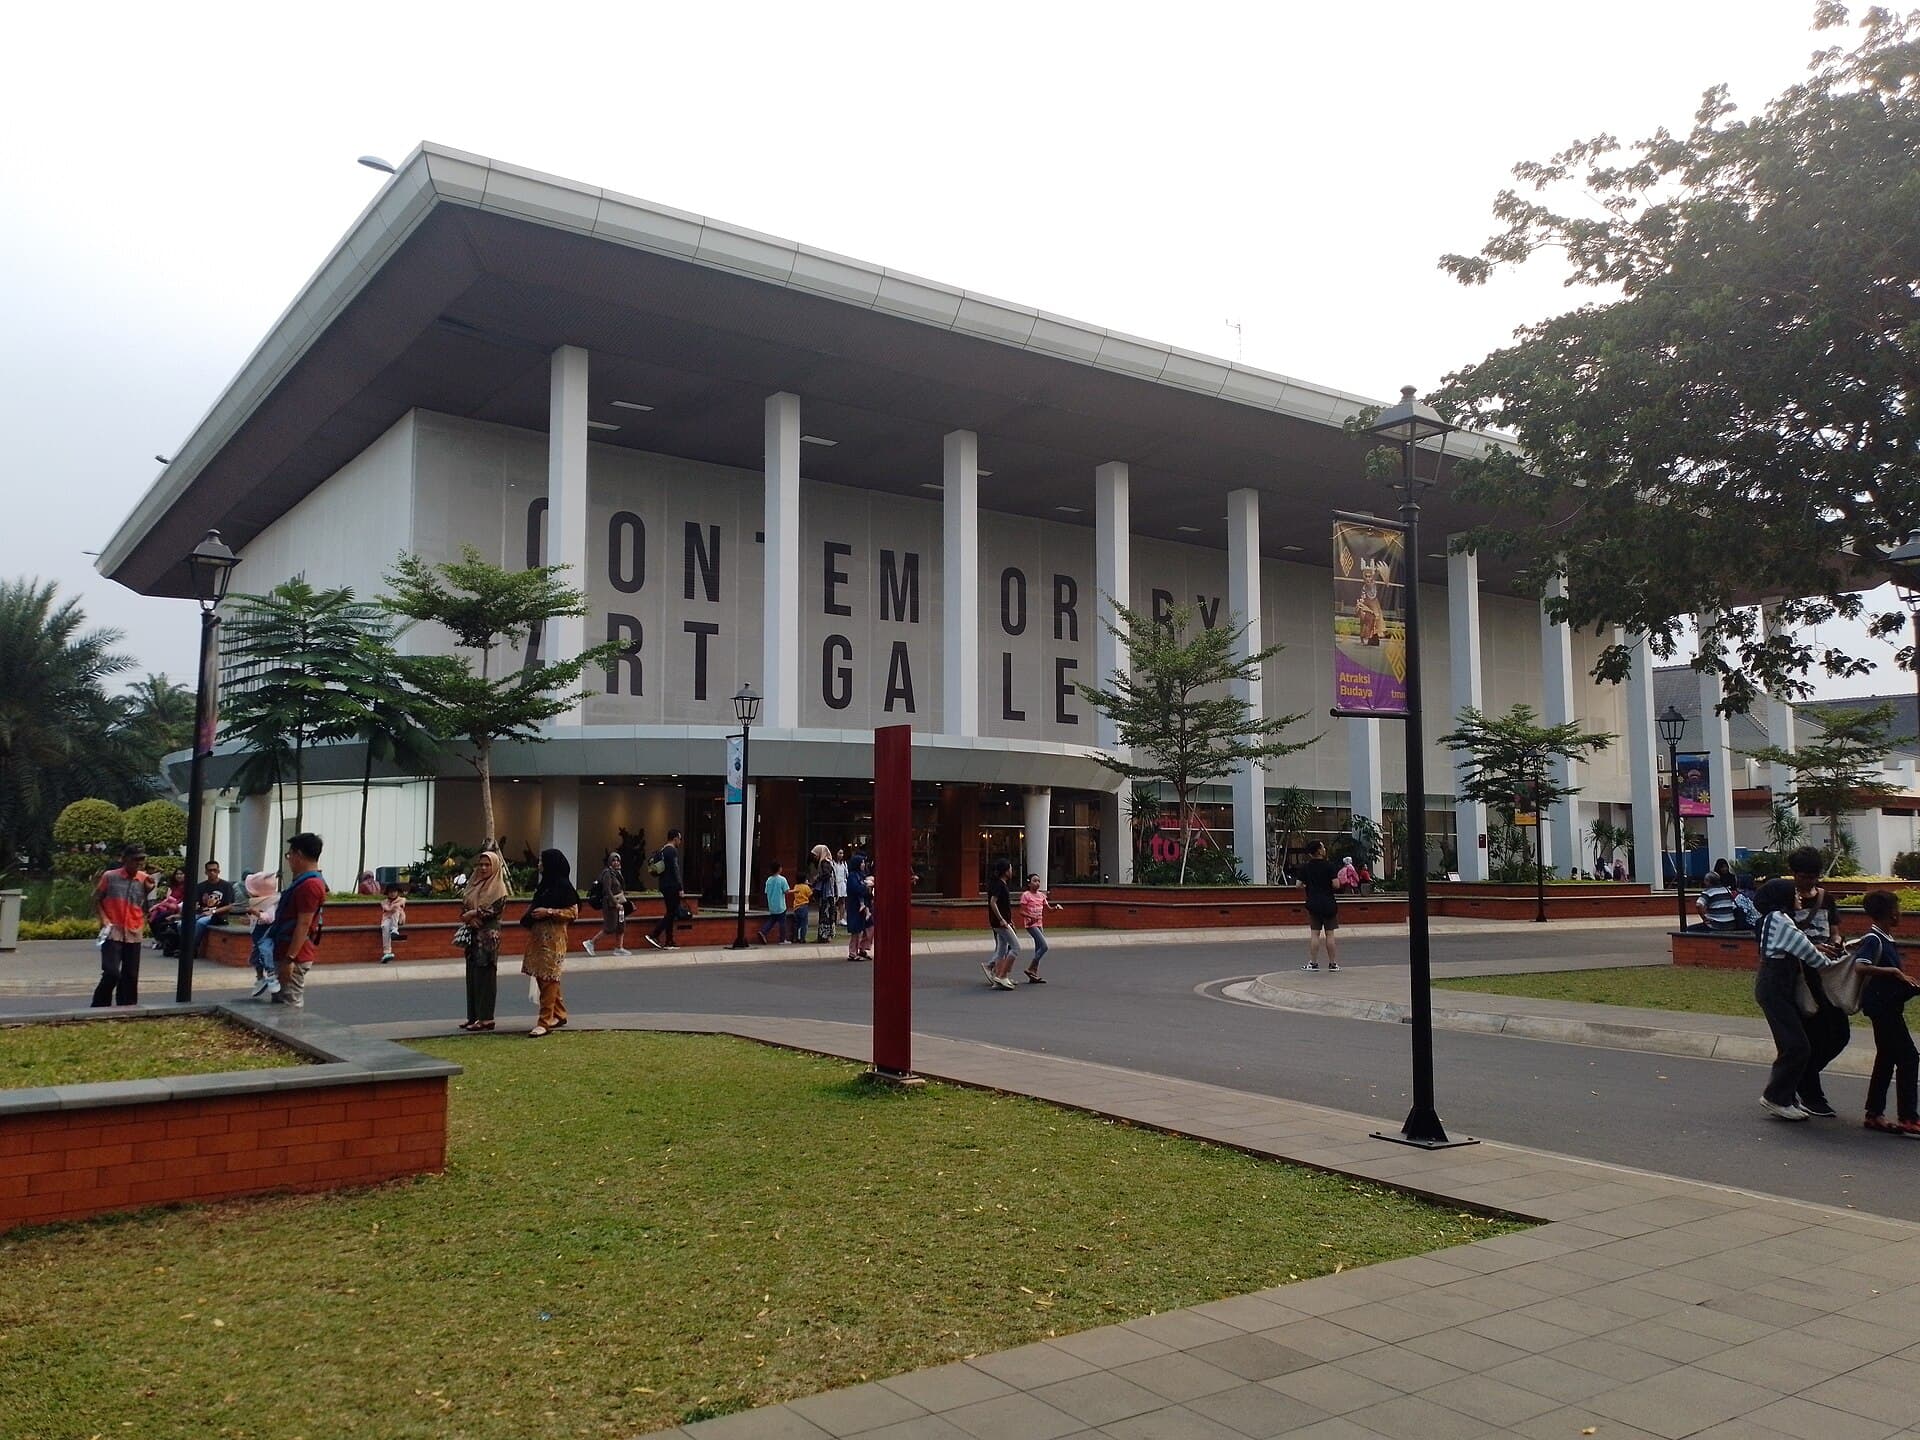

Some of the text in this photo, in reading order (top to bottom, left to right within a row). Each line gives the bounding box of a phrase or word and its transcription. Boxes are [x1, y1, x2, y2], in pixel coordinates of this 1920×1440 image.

[527, 497, 1220, 644] ONEMORRY
[1340, 671, 1371, 684] Atraksi
[1340, 685, 1373, 699] Budaya
